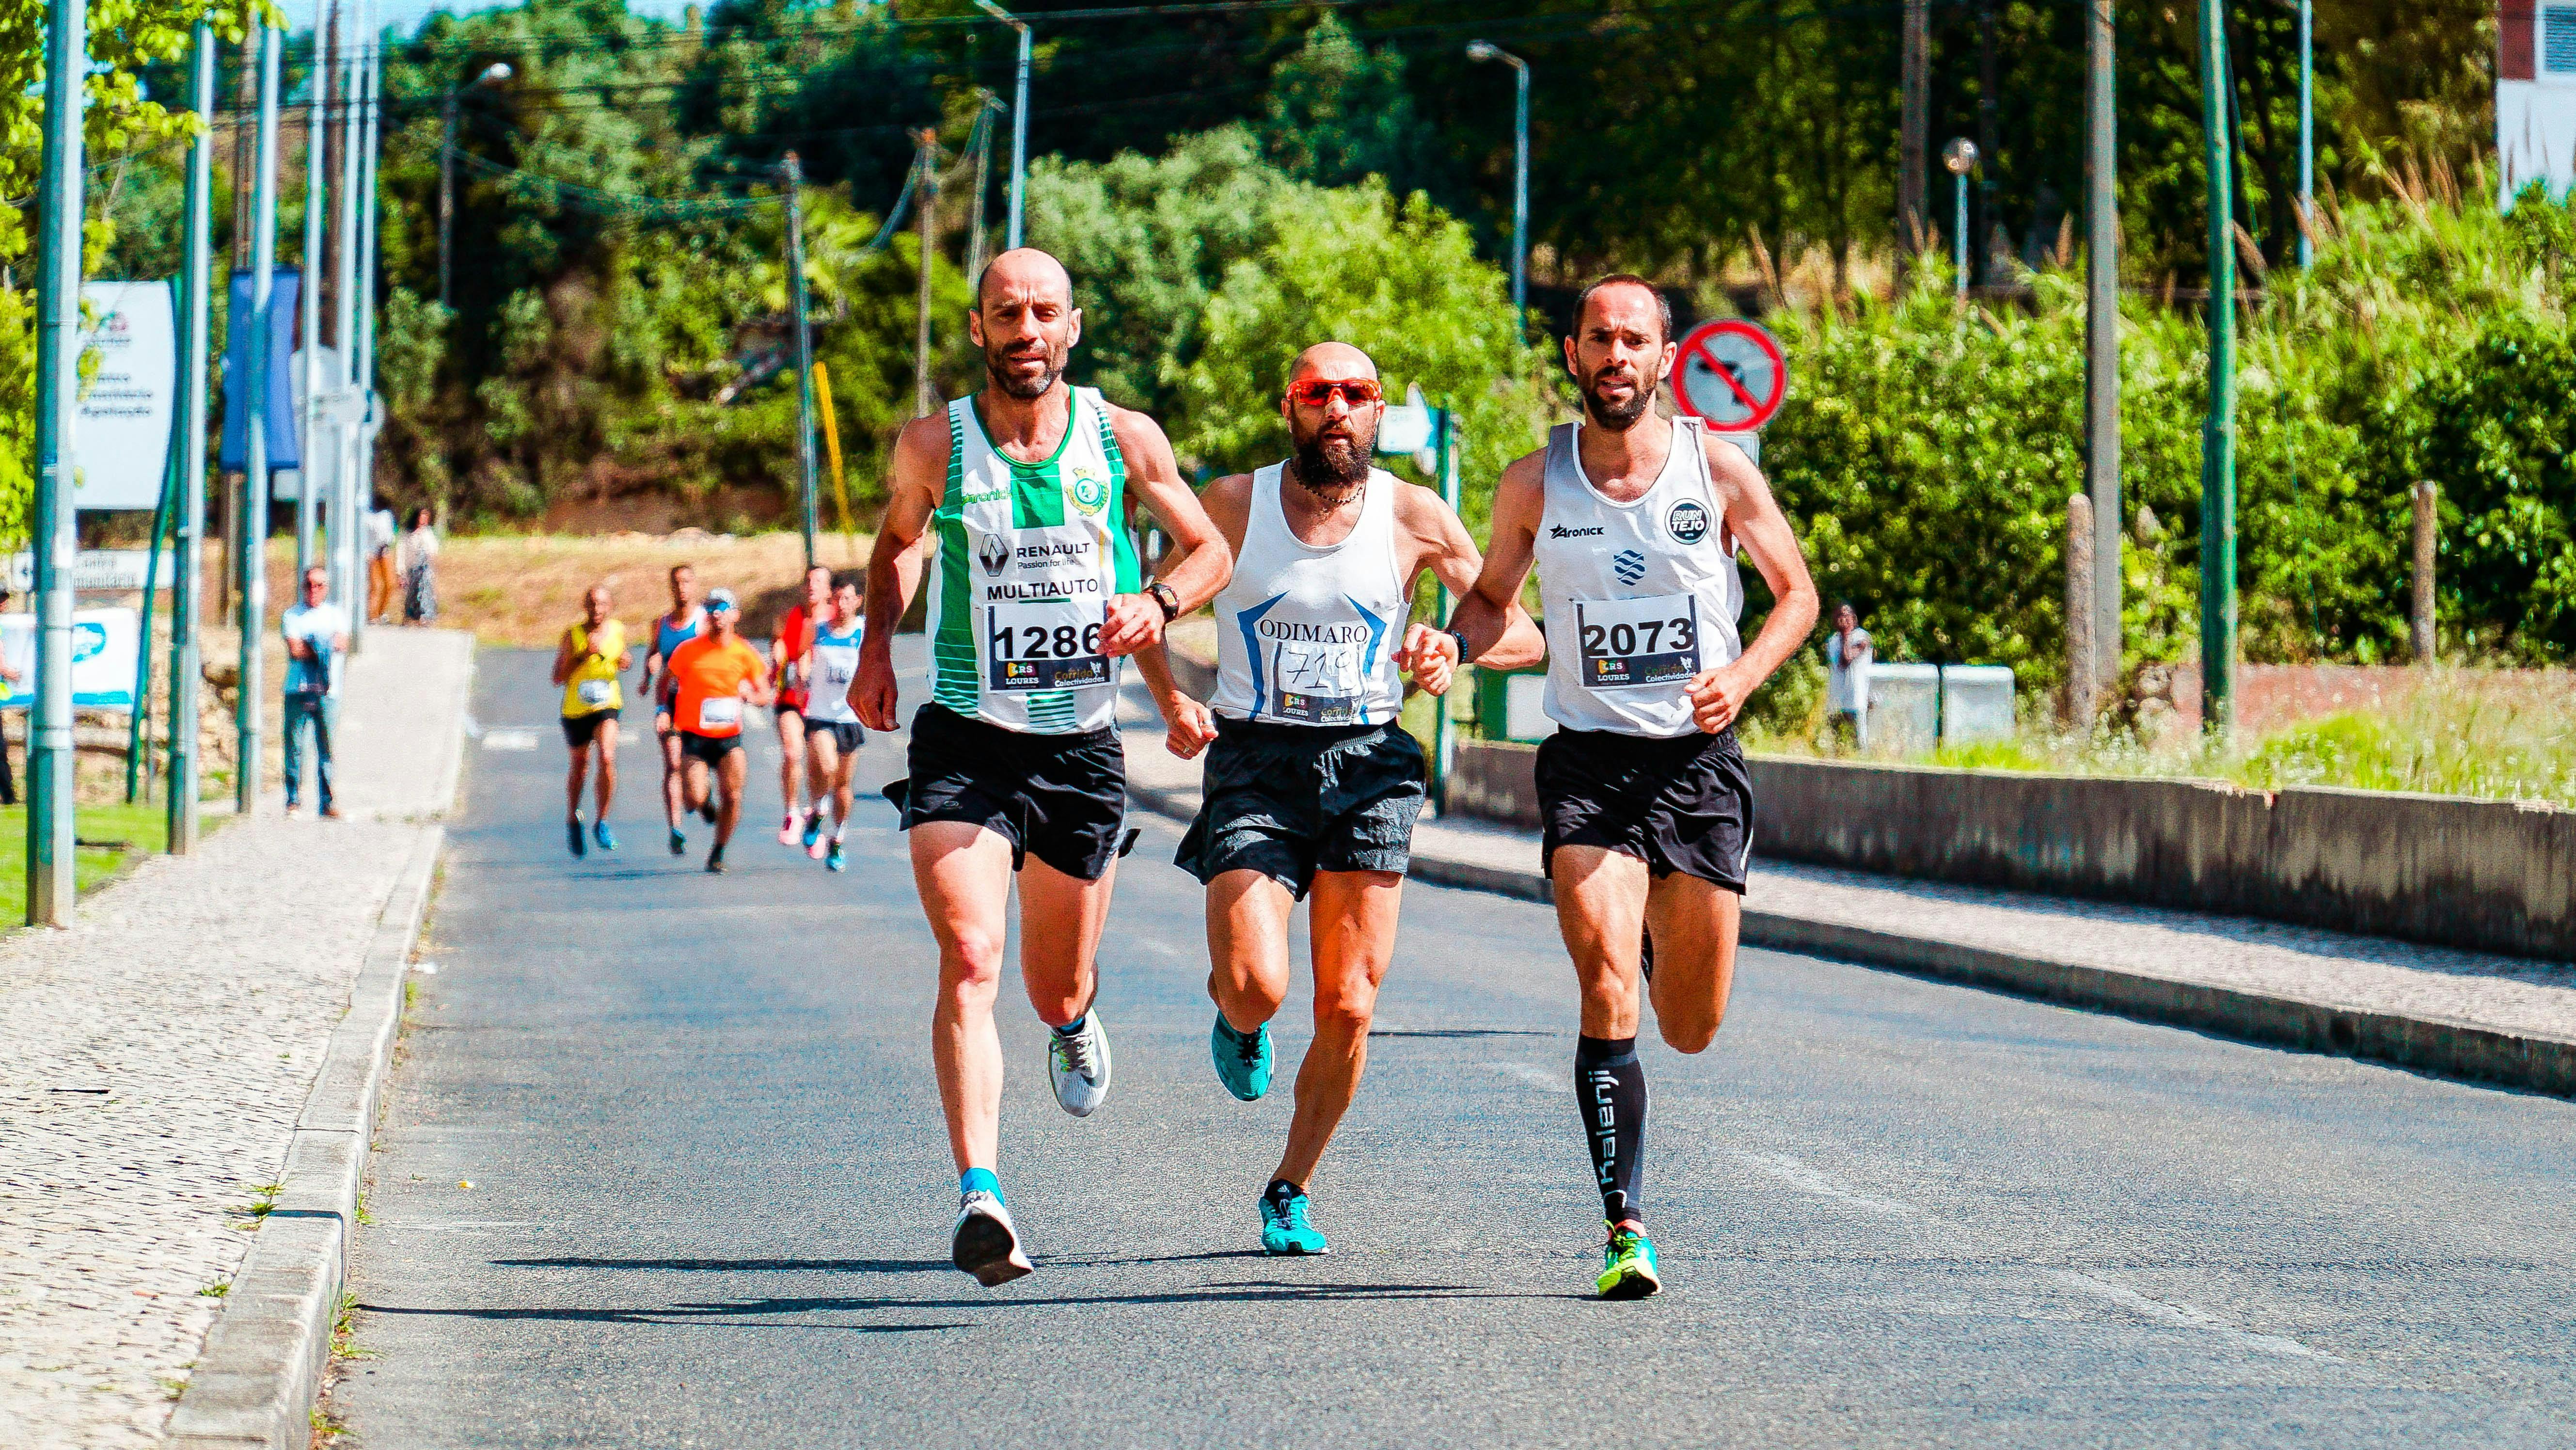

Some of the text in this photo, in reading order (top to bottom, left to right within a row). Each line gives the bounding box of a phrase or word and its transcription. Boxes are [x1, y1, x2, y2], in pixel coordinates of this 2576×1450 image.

[1672, 510, 1703, 521] RUN
[1671, 520, 1705, 531] TEJO
[1016, 543, 1090, 558] RENAULT
[1018, 560, 1048, 569] Passion
[987, 578, 1098, 601] MULTIAUTO
[994, 622, 1105, 659] 1286
[1581, 617, 1694, 656] 2073
[1054, 676, 1105, 687] Colectividades
[1597, 673, 1630, 682] LOURES
